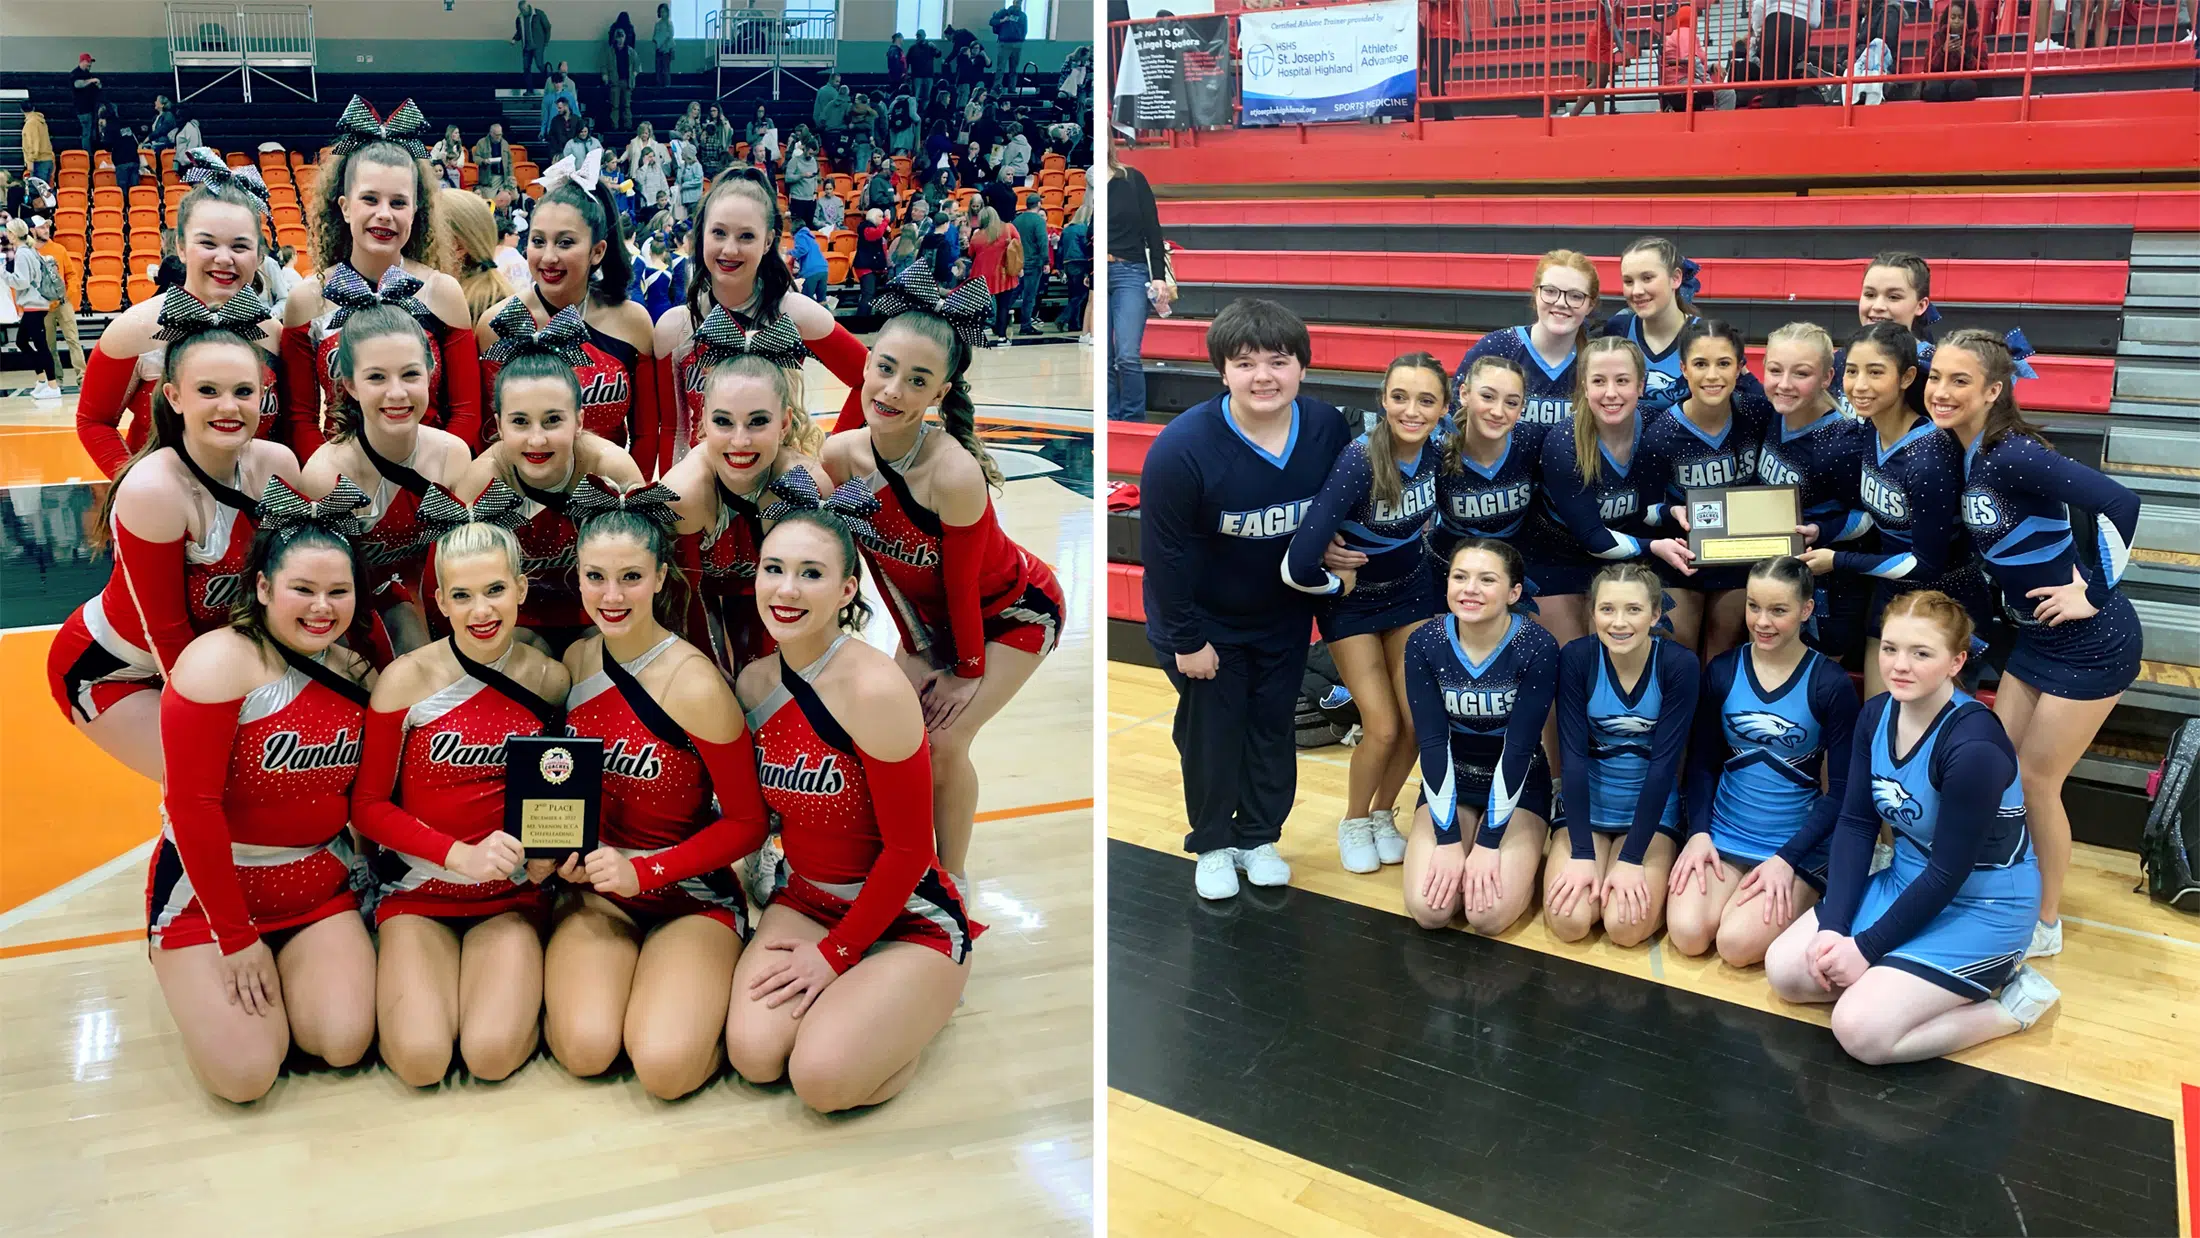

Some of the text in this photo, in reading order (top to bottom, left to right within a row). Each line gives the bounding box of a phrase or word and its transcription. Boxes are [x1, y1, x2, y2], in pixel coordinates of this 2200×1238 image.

[1271, 21, 1296, 30] Certified
[1323, 17, 1346, 26] Trainer
[1347, 13, 1375, 25] provided
[1376, 13, 1384, 22] by
[1158, 28, 1170, 37] To
[1276, 42, 1297, 51] HSHS
[1361, 43, 1398, 54] Athletes
[1278, 50, 1335, 65] St. Joseph's
[1361, 54, 1409, 67] Advantage
[1278, 63, 1353, 78] Hospital Highland
[1334, 98, 1408, 112] SPORTS MEDICINE
[1678, 449, 1755, 487] EAGLES
[1451, 483, 1531, 518] EAGLES
[1443, 689, 1517, 716] AGLES
